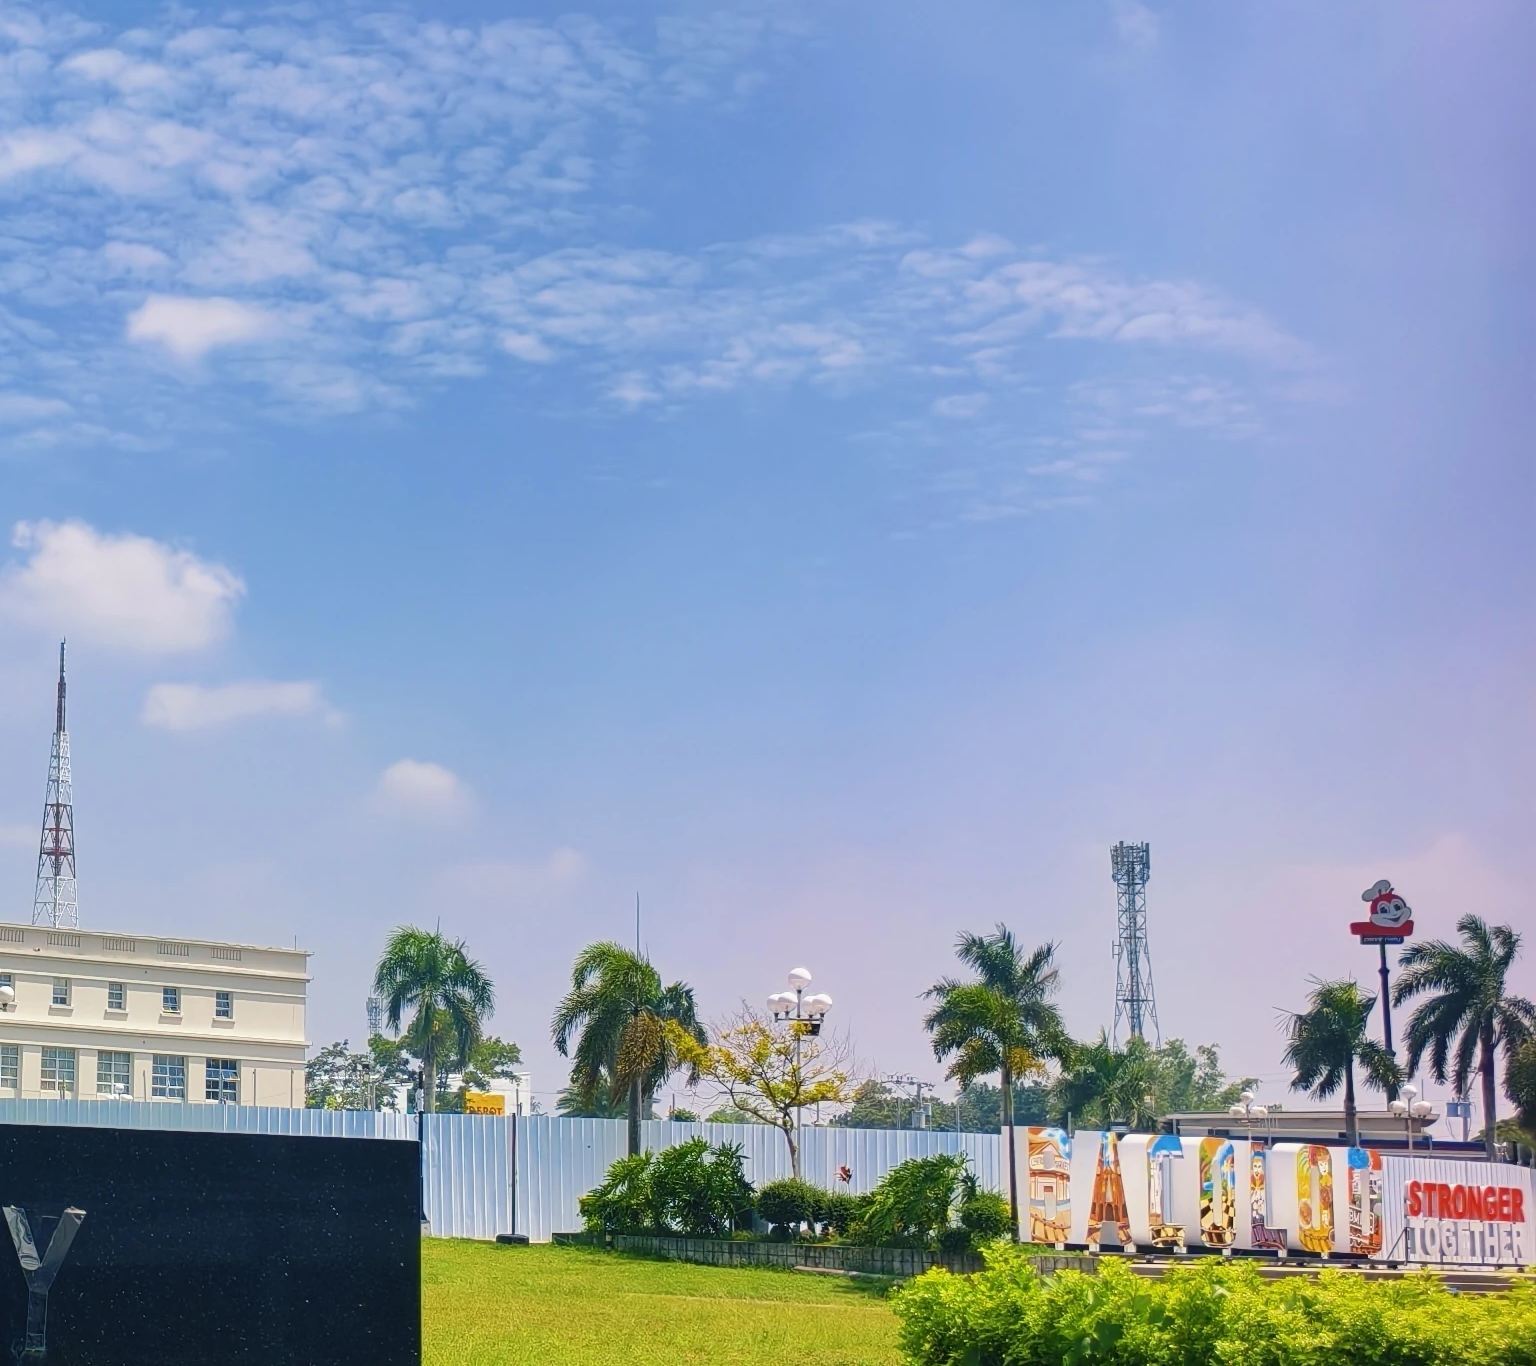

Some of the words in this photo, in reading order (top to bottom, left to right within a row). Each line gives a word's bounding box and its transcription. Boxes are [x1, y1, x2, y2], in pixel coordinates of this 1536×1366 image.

[1027, 1126, 1383, 1256] BACOLOD
[1407, 1180, 1525, 1223] STRONGER
[1408, 1218, 1524, 1259] TOGETHER
